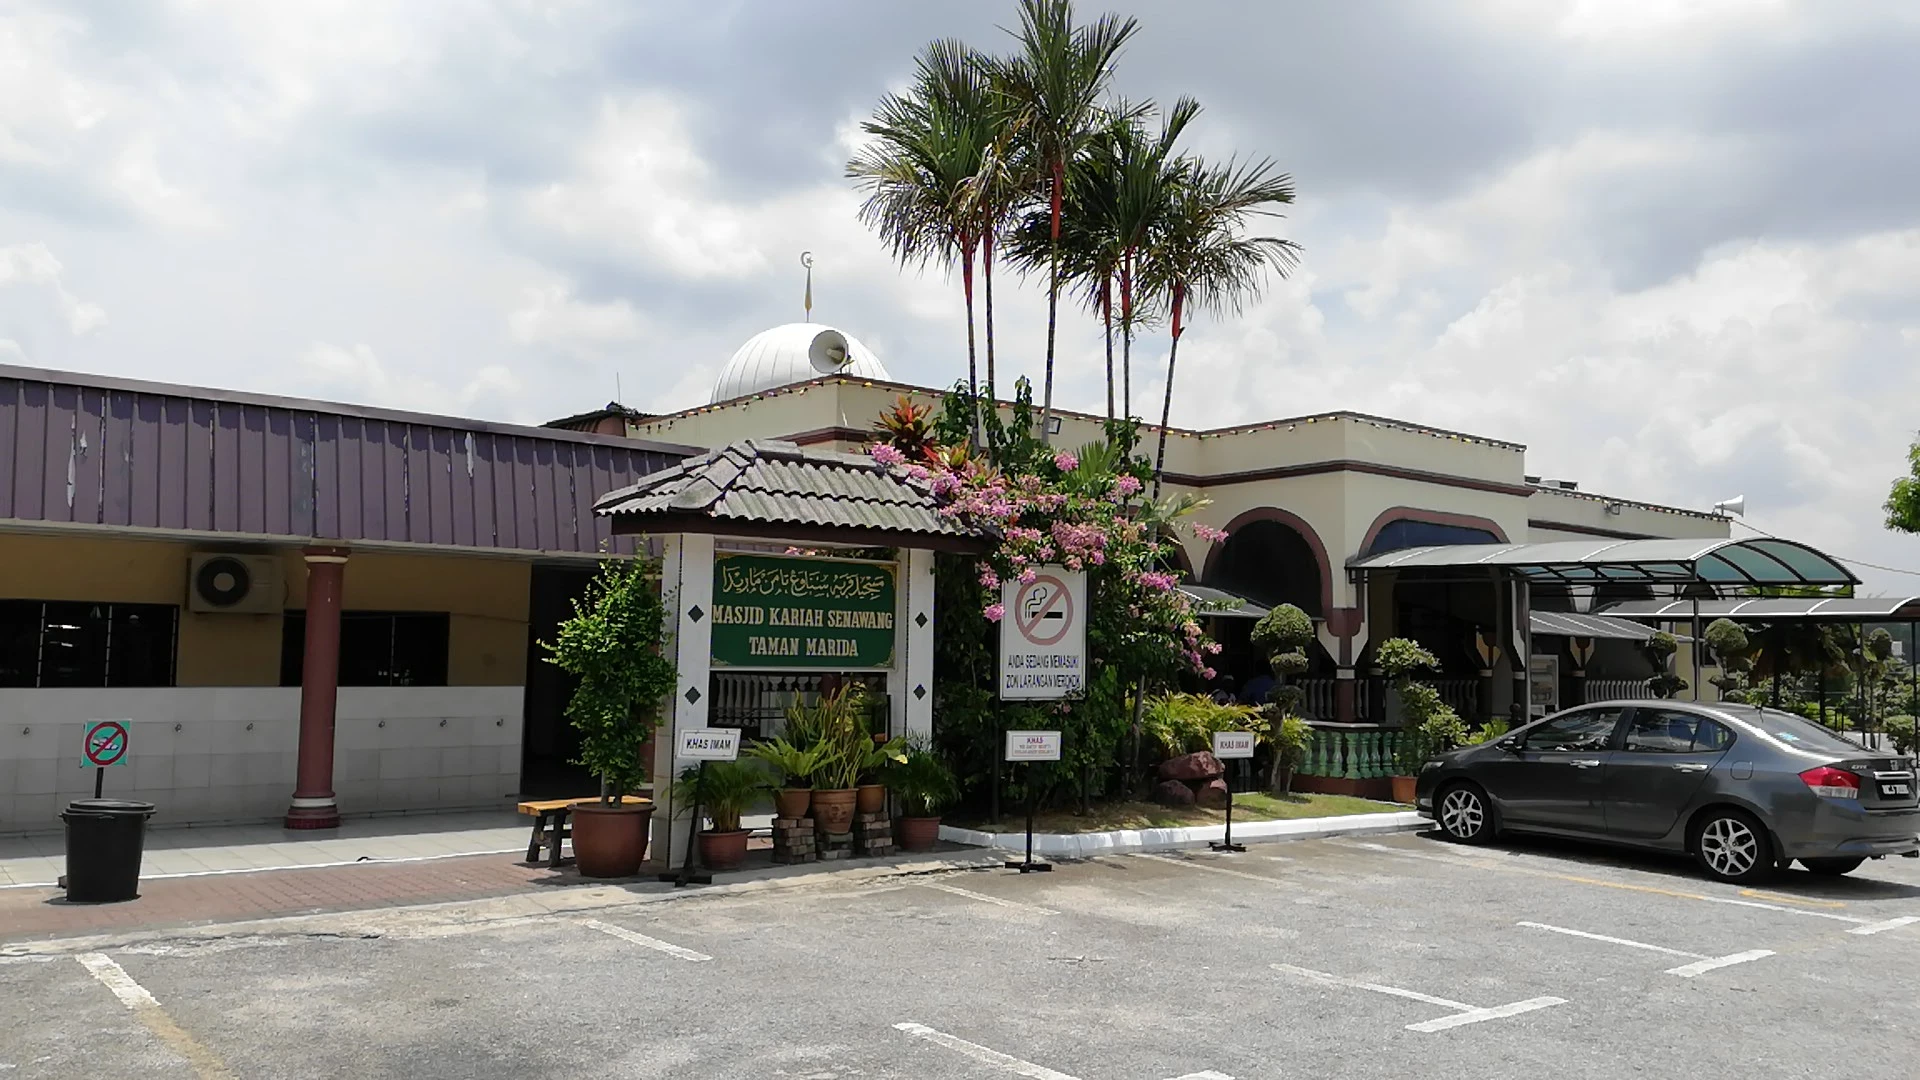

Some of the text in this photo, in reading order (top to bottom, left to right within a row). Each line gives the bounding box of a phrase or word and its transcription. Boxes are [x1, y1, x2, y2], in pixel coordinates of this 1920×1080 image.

[712, 604, 893, 630] MASJID KARIAH SENAWANG
[749, 636, 859, 657] TAMAN MARIDA
[1008, 654, 1024, 669] ANDA
[1025, 654, 1049, 669] SEDANG
[686, 738, 731, 750] KHAS IMAM
